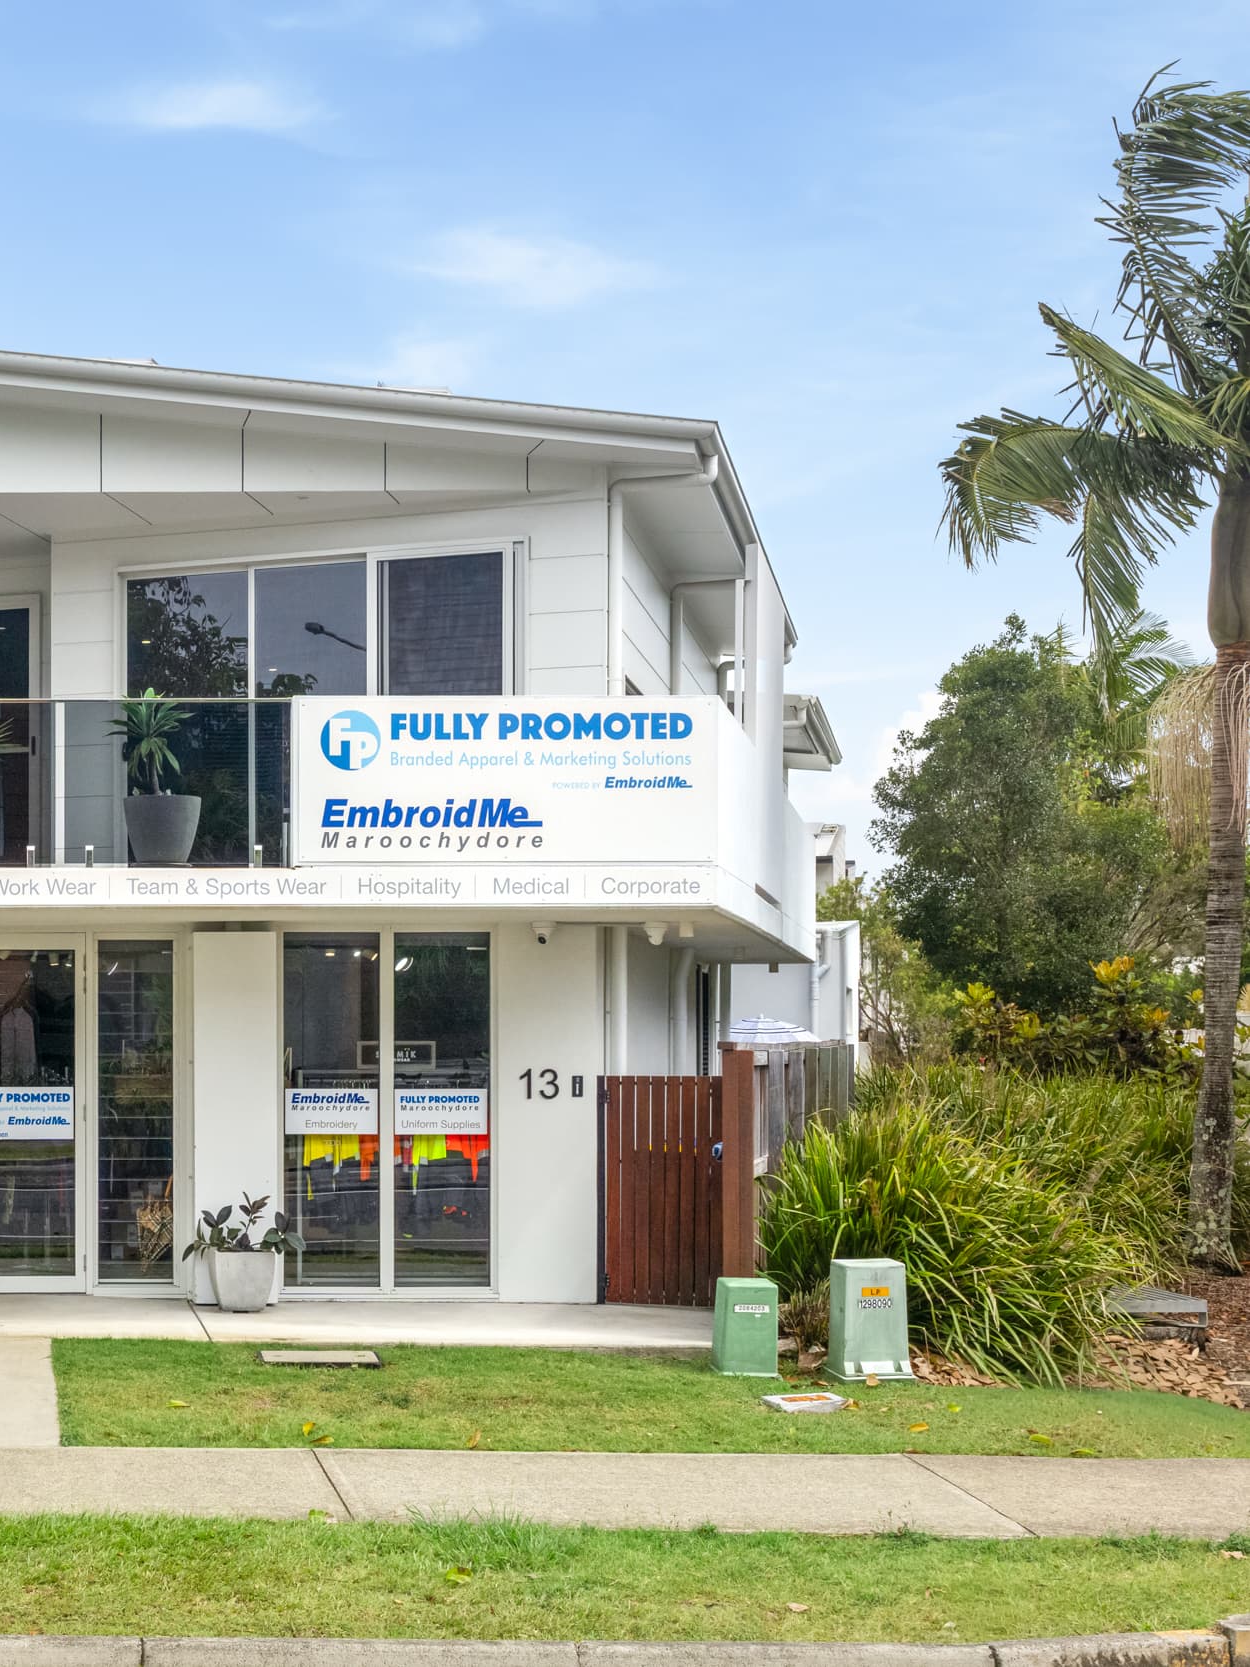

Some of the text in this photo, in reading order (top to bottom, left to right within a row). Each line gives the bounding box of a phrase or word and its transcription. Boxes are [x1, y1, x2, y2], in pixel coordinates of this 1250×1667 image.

[391, 713, 692, 740] FULLY PROMOTED
[391, 751, 691, 769] Branded Apparel & Marketing Solutions
[605, 776, 693, 788] EmbroidMe
[321, 799, 543, 828] EmbroidMe
[321, 832, 543, 852] Maroochydore
[46, 878, 97, 895] Wear
[126, 878, 180, 895] Team
[186, 878, 198, 895] &
[206, 878, 270, 899] Sports
[276, 878, 326, 895] Wear
[358, 878, 461, 899] Hospitality
[494, 878, 569, 894] Medical
[601, 877, 700, 898] Corporate
[519, 1068, 559, 1099] 13
[6, 1093, 70, 1102] PROMOTED
[291, 1093, 369, 1104] EmbroidMe
[291, 1104, 370, 1112] Maroochydore
[401, 1104, 478, 1112] Maroochydore
[8, 1116, 70, 1125] EmbroidMe
[305, 1120, 357, 1130] Embroidery
[401, 1120, 480, 1130] Uniform Supplies
